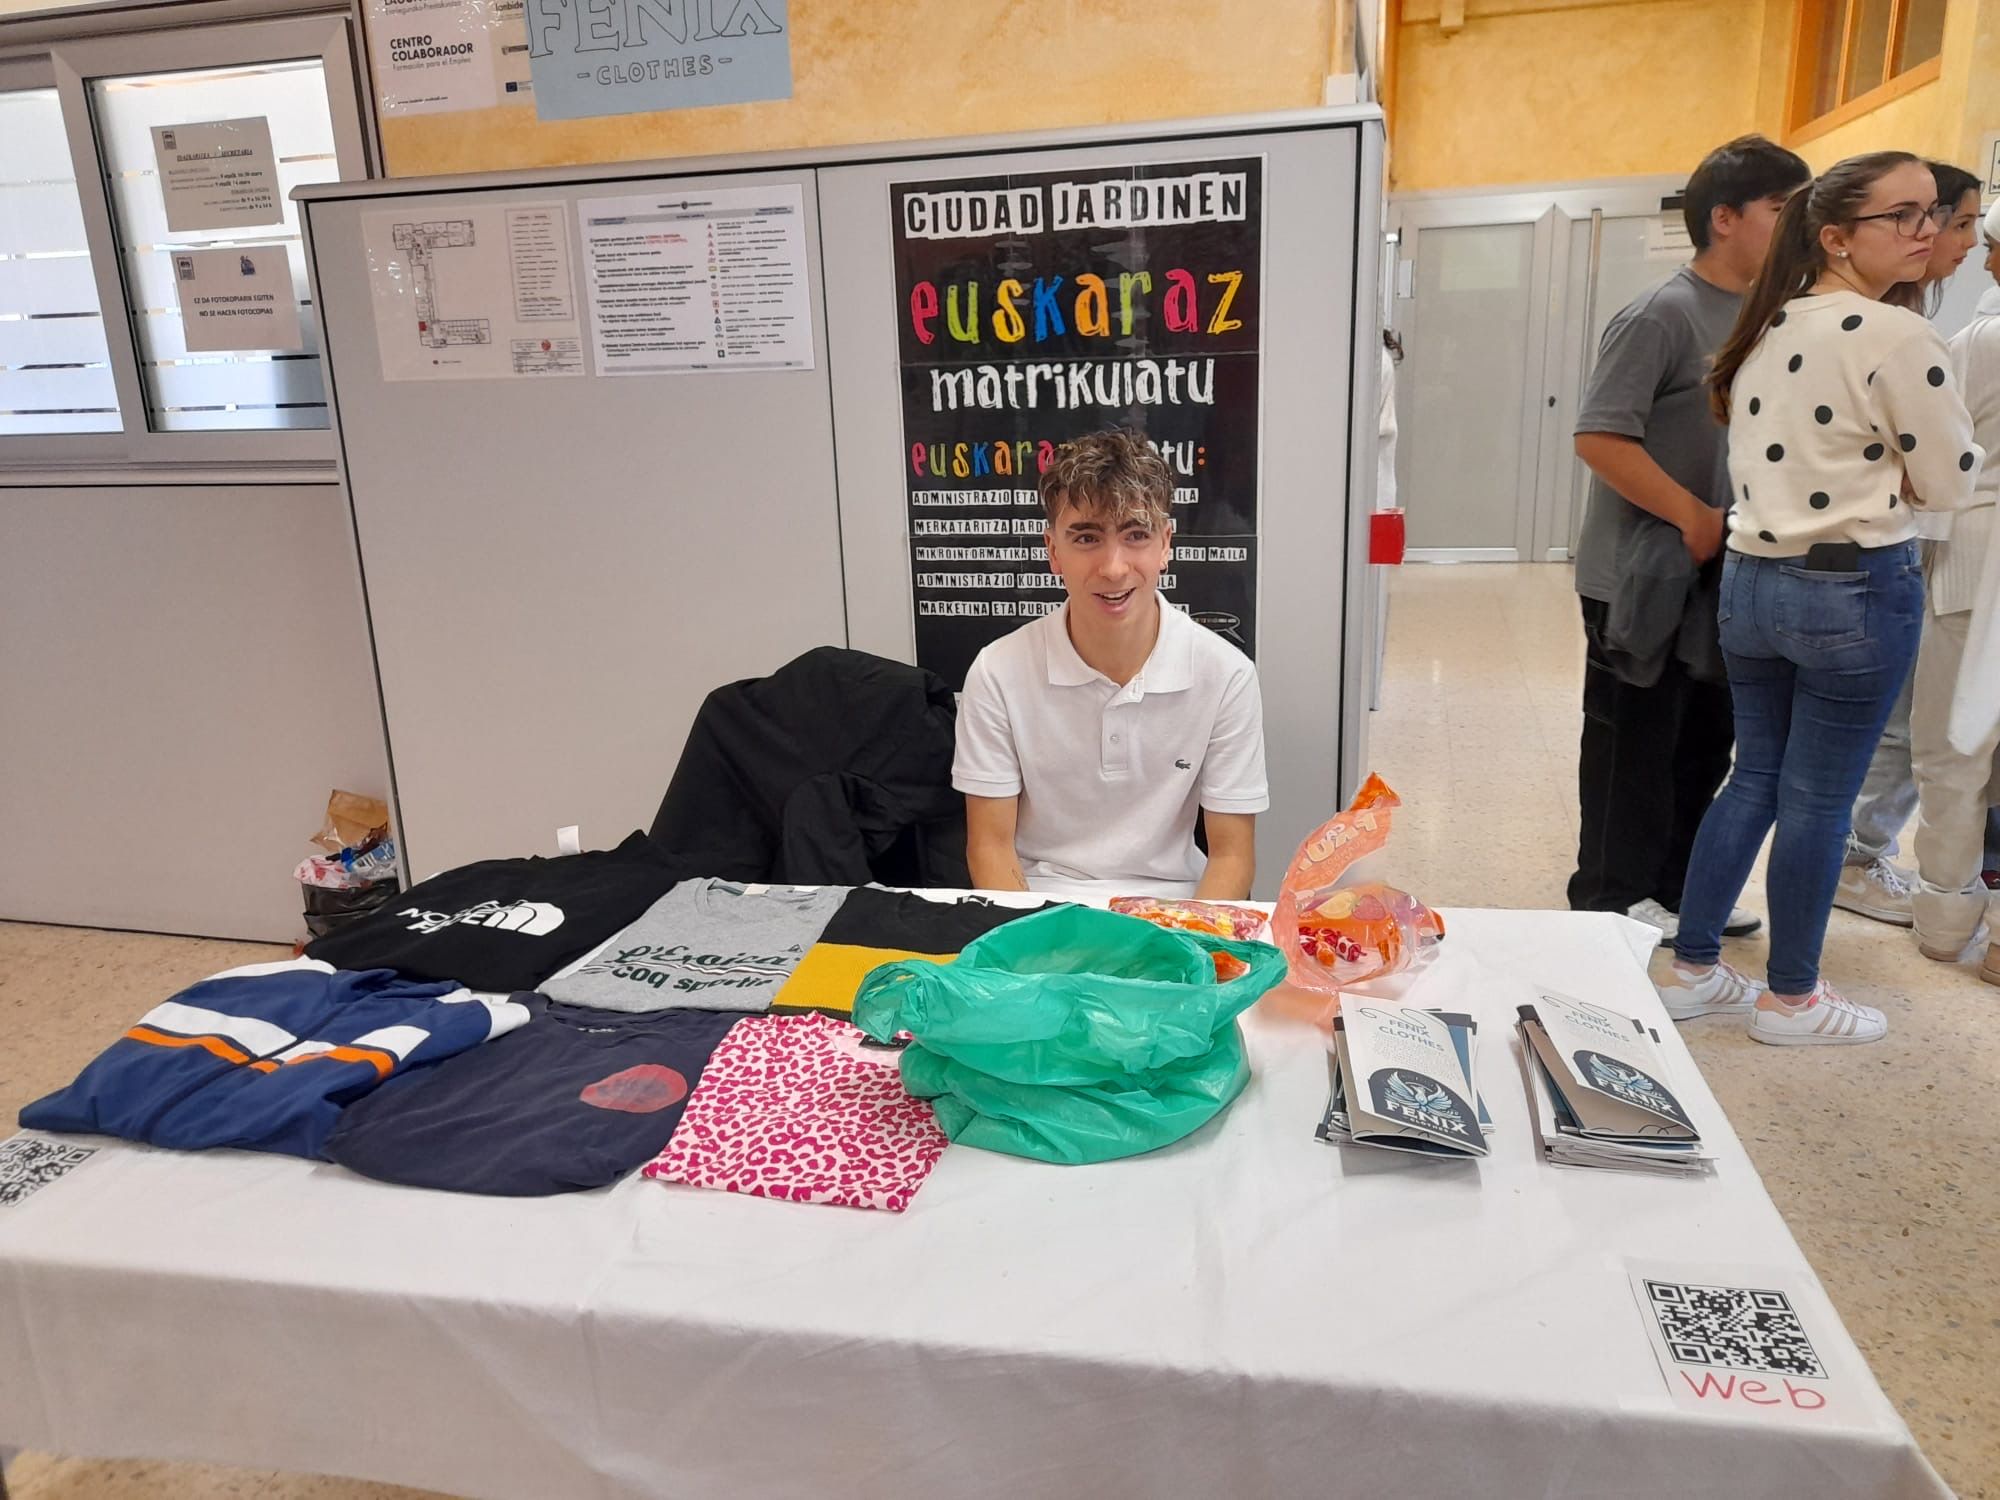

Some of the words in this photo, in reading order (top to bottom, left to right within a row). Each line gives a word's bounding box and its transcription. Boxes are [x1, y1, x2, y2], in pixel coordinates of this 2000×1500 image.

[390, 35, 433, 49] CENTRO
[392, 43, 474, 62] COLABORADOR
[907, 192, 1040, 233] CIUDAD
[1057, 179, 1243, 224] JARDINEN
[911, 268, 1244, 344] euskaraz
[930, 358, 1215, 411] matrikulatu
[911, 440, 1074, 478] euskara
[913, 490, 1010, 504] ADMINISTRAZIO
[1015, 490, 1037, 503] ETA
[914, 520, 1009, 534] MERKATARITZA
[916, 548, 1028, 560] MIKROINFORMATIKA
[1177, 548, 1205, 560] ERDI
[1209, 548, 1246, 560] MAILA
[917, 574, 1013, 587] ADMINISTRAZIO
[920, 602, 988, 615] MARKETINA
[994, 603, 1015, 615] ETA
[612, 965, 670, 988] coq
[1378, 1025, 1445, 1052] CLOTHES
[1389, 1019, 1431, 1039] FENIX
[1564, 1014, 1631, 1042] CLOTHES
[1384, 1100, 1470, 1136] FENIX
[1680, 1370, 1826, 1410] Web
